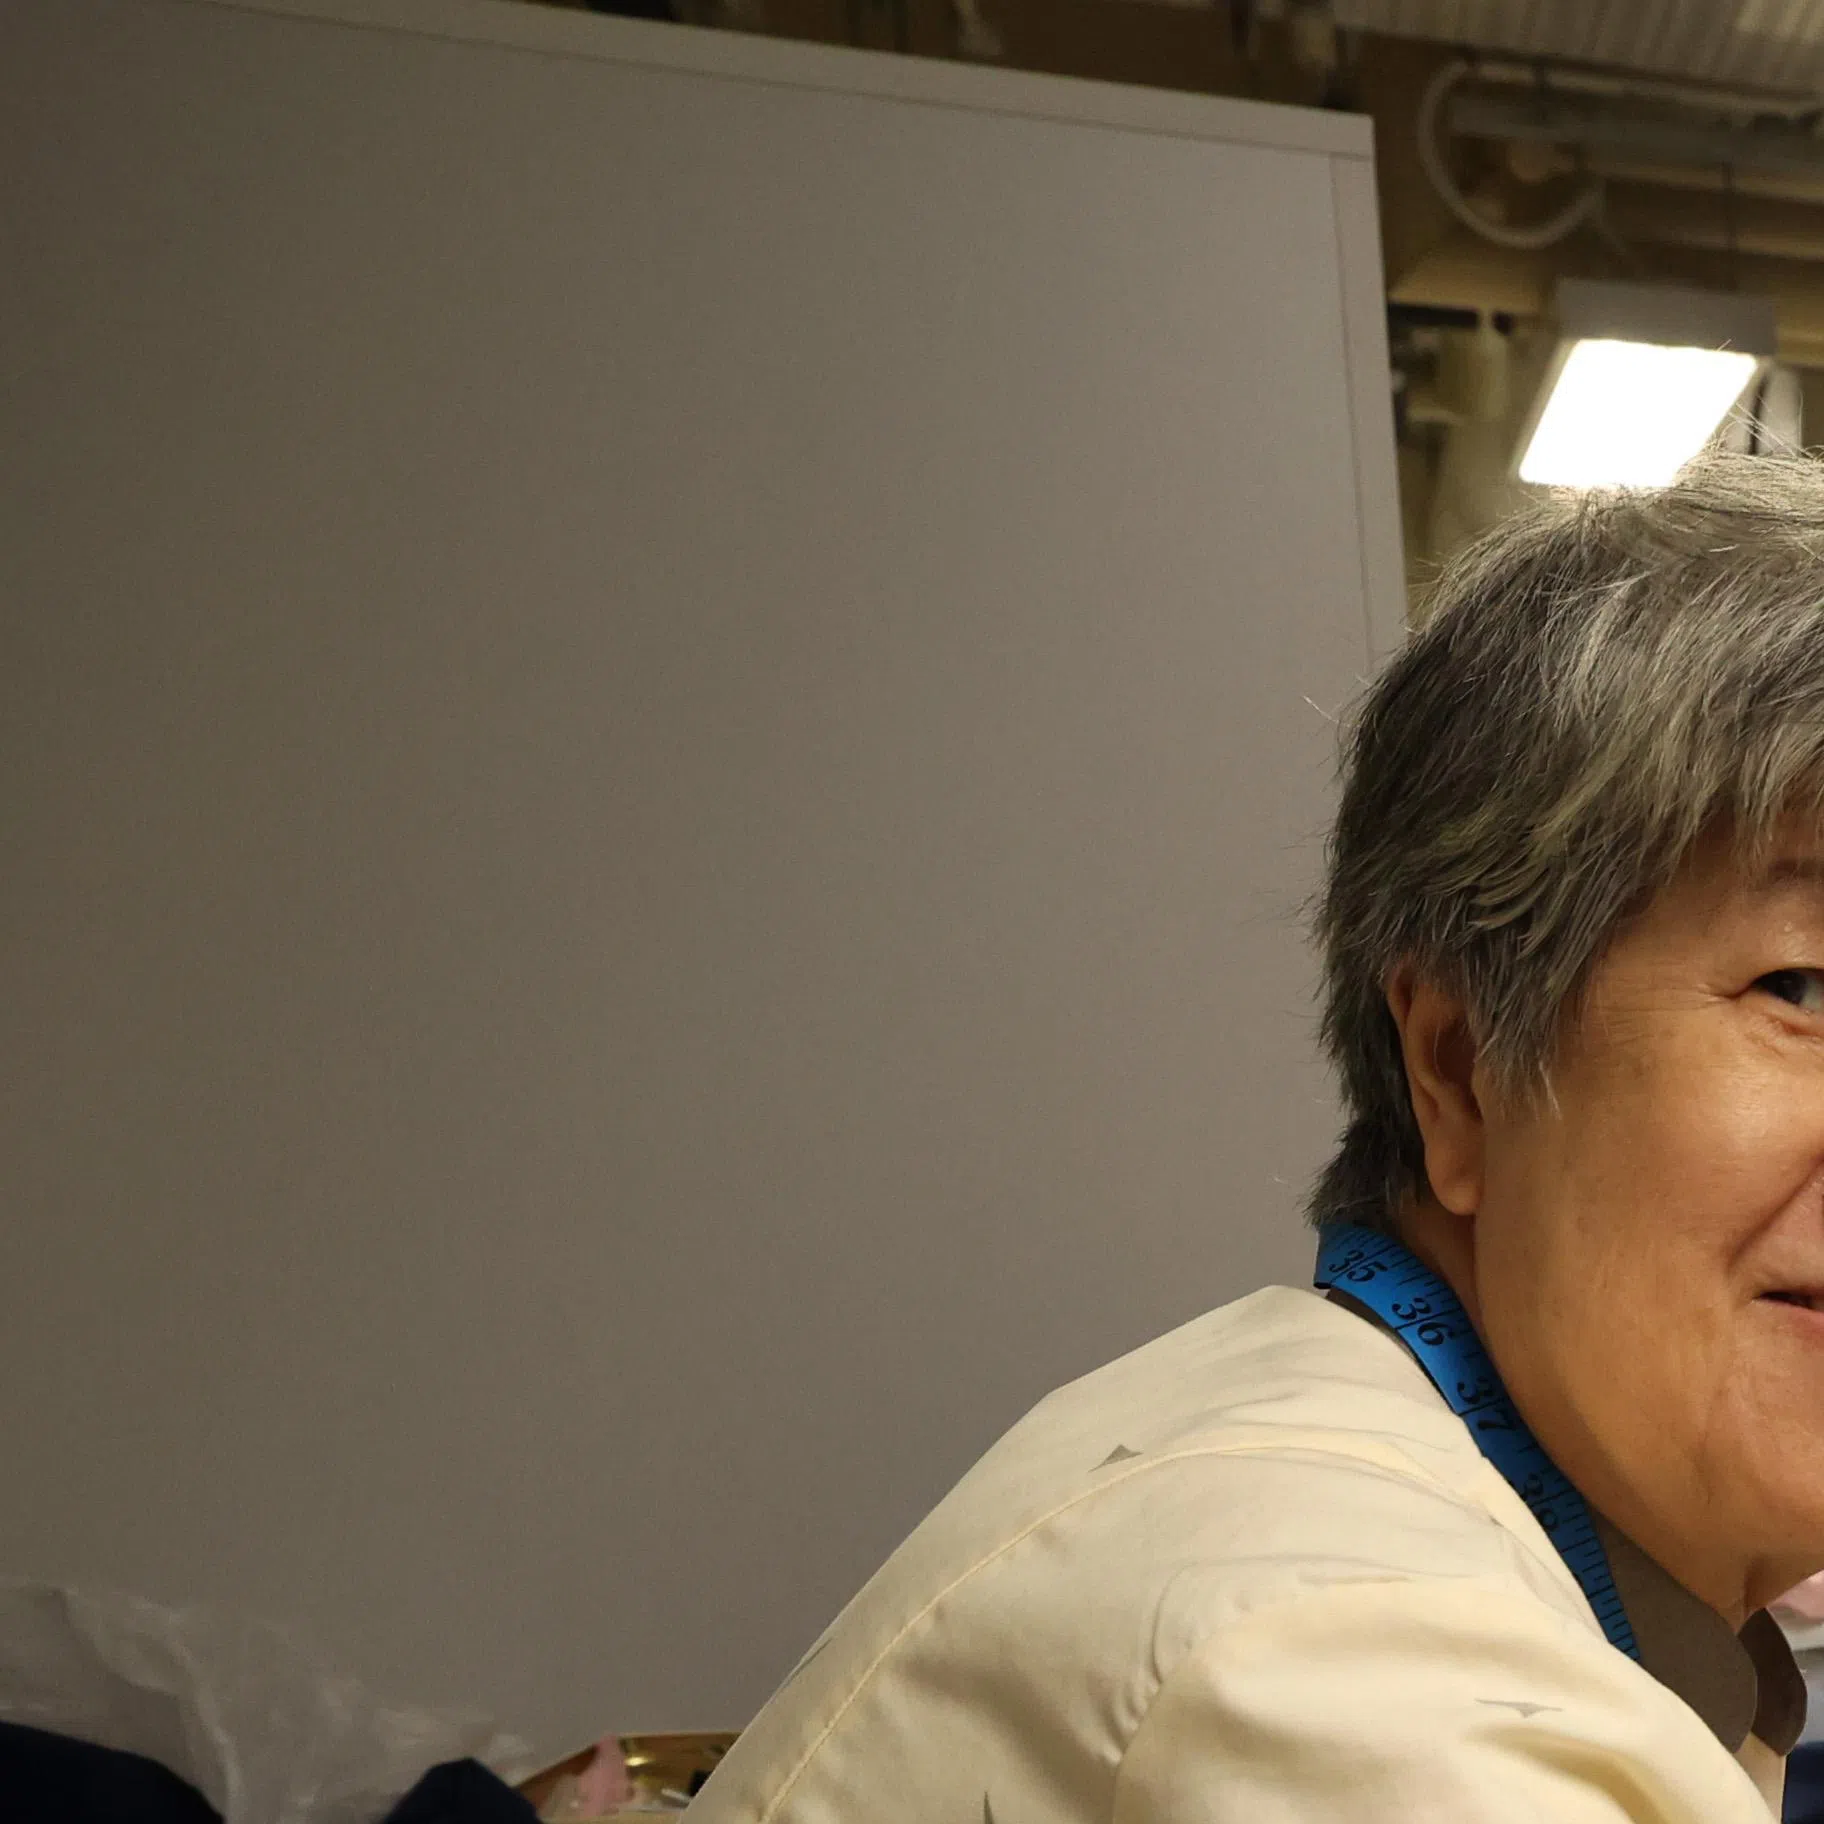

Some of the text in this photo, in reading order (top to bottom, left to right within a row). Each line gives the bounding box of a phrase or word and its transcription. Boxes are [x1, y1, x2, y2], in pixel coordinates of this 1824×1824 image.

[1328, 1250, 1388, 1284] 35
[1391, 1296, 1456, 1347] 36
[1455, 1378, 1518, 1433] 37
